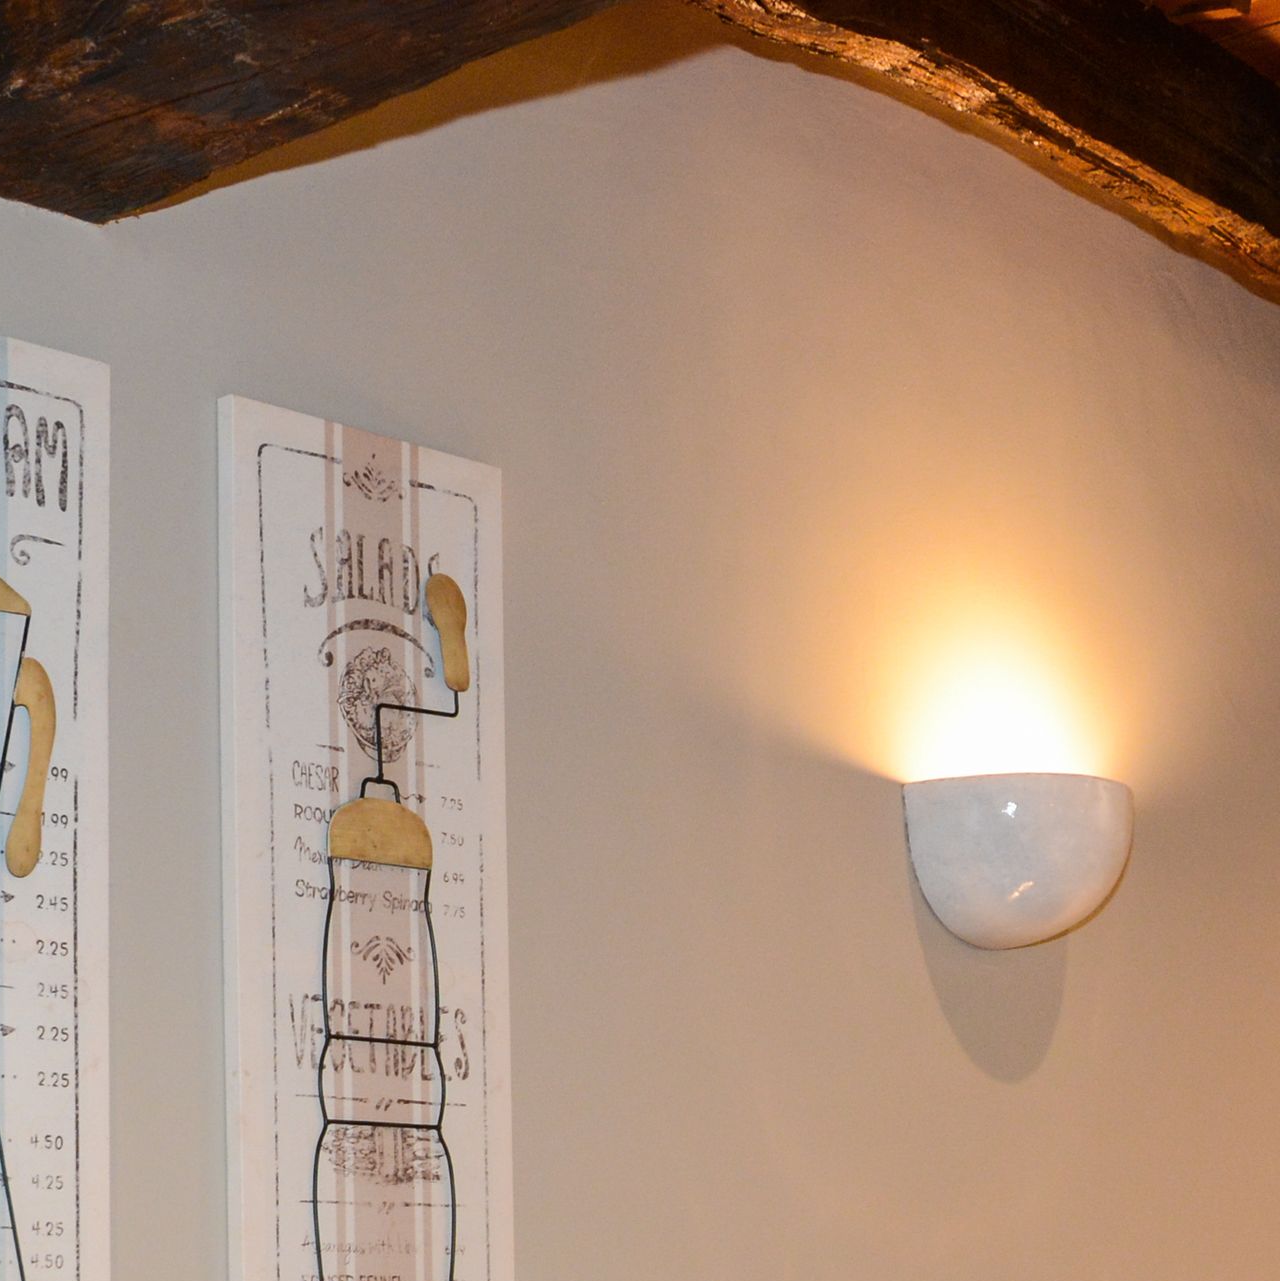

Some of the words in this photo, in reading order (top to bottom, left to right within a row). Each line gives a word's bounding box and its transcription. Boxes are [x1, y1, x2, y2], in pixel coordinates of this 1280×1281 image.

[292, 760, 340, 793] CAESAR
[36, 894, 69, 912] 2.45
[295, 879, 375, 913] Straberry
[36, 939, 69, 957] 2.25
[37, 982, 69, 999] 2.45
[36, 1025, 69, 1042] 2.25
[37, 1071, 70, 1088] 2.25
[30, 1134, 64, 1151] 4.50
[32, 1174, 64, 1190] 4.25
[32, 1221, 64, 1237] 4.25
[30, 1254, 65, 1269] 4.50
